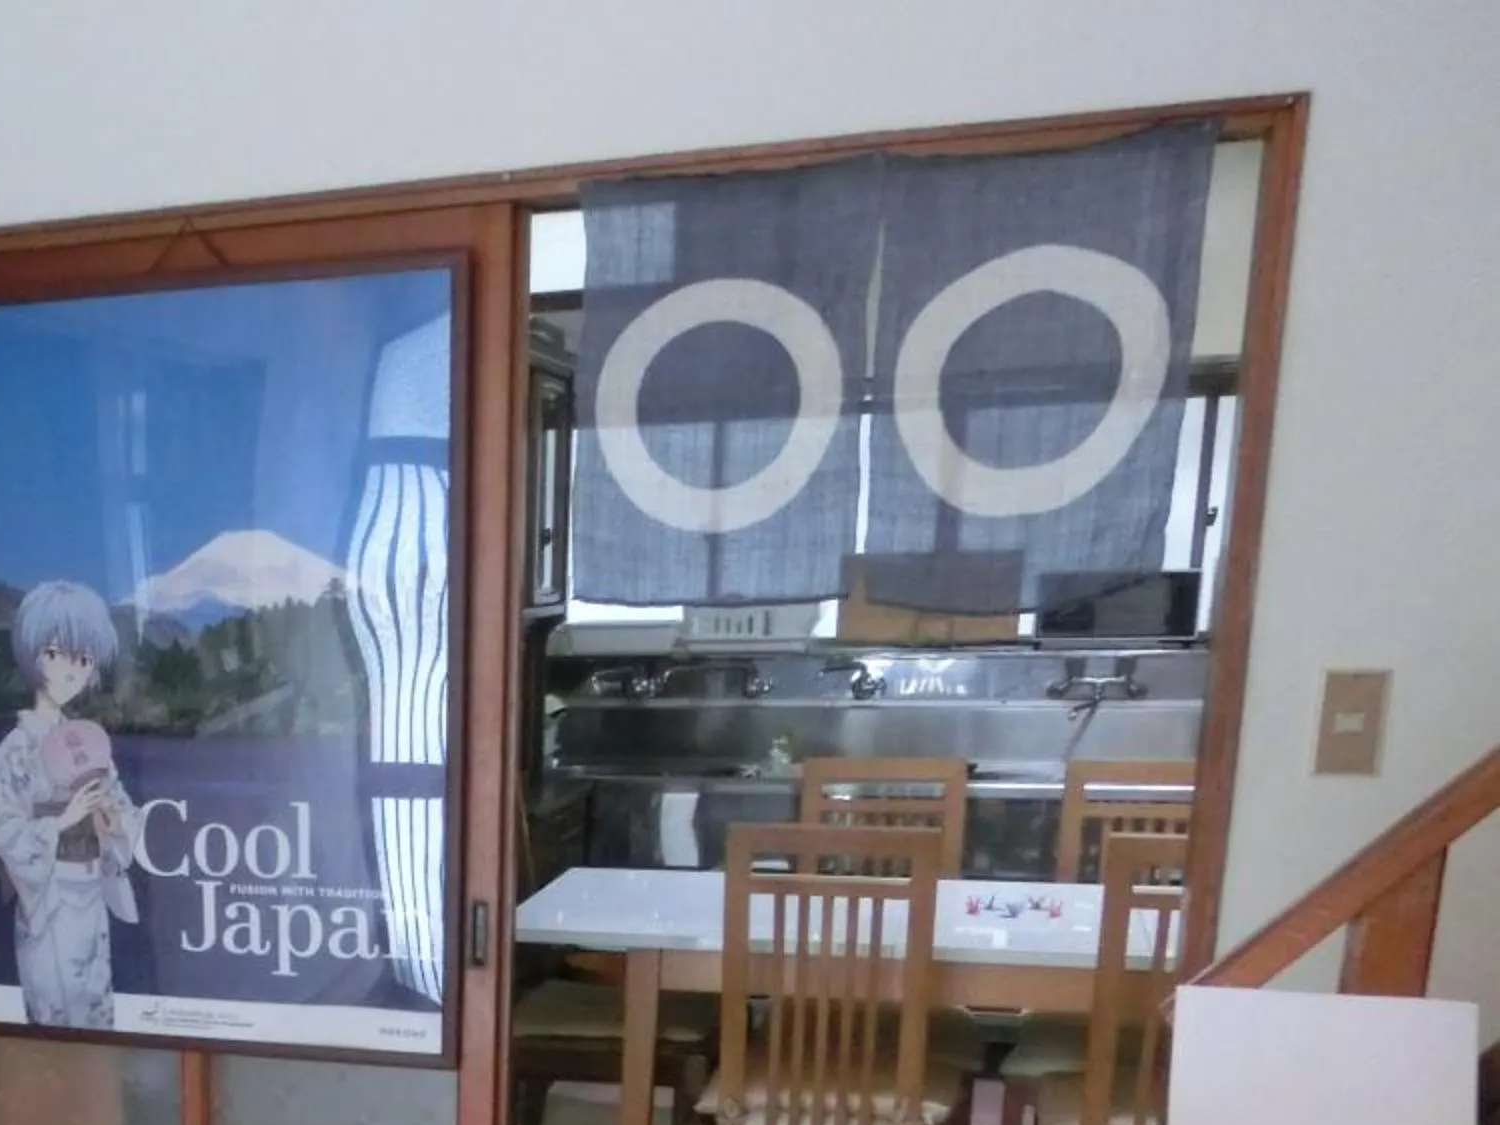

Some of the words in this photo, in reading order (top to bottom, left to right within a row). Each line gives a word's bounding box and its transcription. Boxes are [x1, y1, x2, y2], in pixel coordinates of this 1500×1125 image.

[132, 798, 318, 879] Cool
[229, 883, 278, 897] FUSION
[281, 885, 315, 898] WITH
